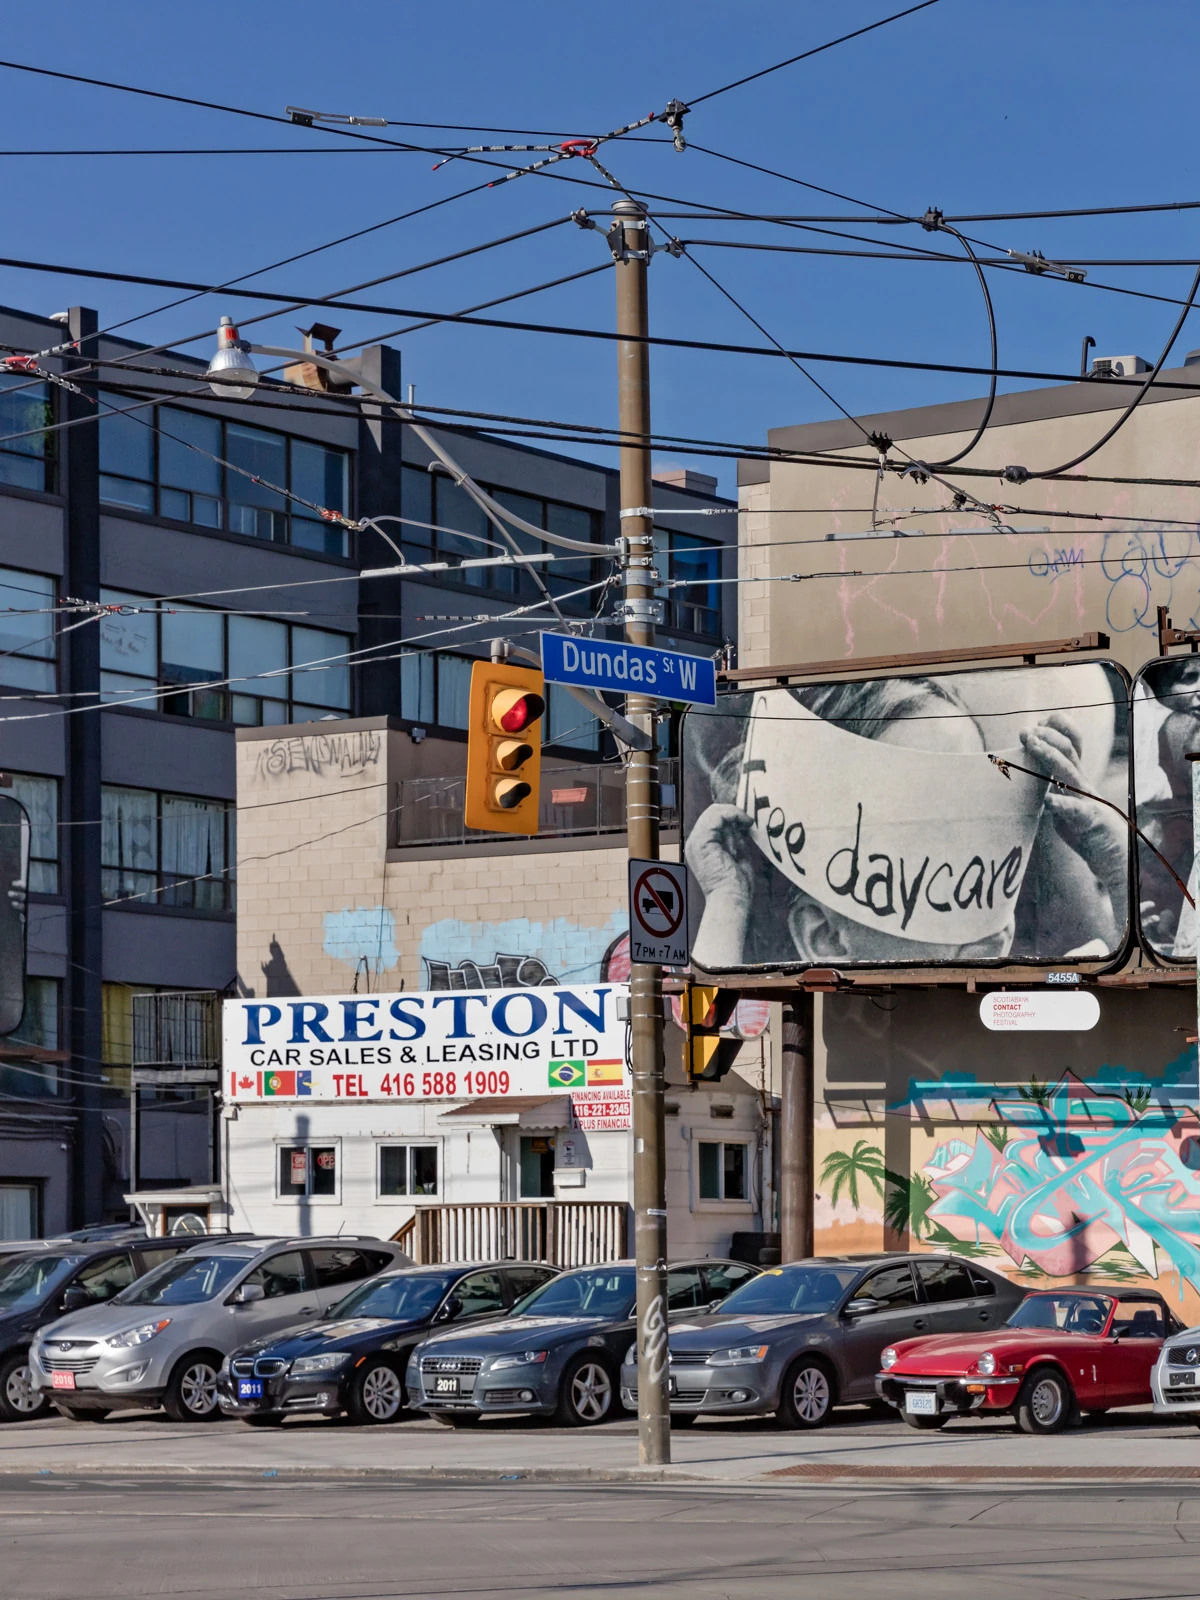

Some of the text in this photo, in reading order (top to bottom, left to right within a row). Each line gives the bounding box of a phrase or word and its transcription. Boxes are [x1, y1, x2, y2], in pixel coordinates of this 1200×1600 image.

[562, 640, 697, 691] Dundas St W
[826, 802, 1022, 932] daycare
[634, 942, 642, 957] 7
[643, 946, 656, 958] PM
[663, 945, 671, 959] 7
[673, 949, 686, 961] AM
[1048, 973, 1079, 983] 5455A
[241, 988, 613, 1045] PRESTON
[993, 1011, 1036, 1019] PHOTOGRAPHY
[250, 1038, 599, 1067] CAR SALES & LEASING LTD
[332, 1070, 510, 1097] TEL 416 588 1909
[572, 1089, 631, 1101] FINANCING AVAILABLE
[573, 1118, 631, 1130] A PLUS FINANCIAL
[317, 1153, 336, 1168] OPE
[54, 1374, 73, 1385] 2010
[437, 1379, 457, 1392] 2011
[240, 1383, 261, 1395] 2011
